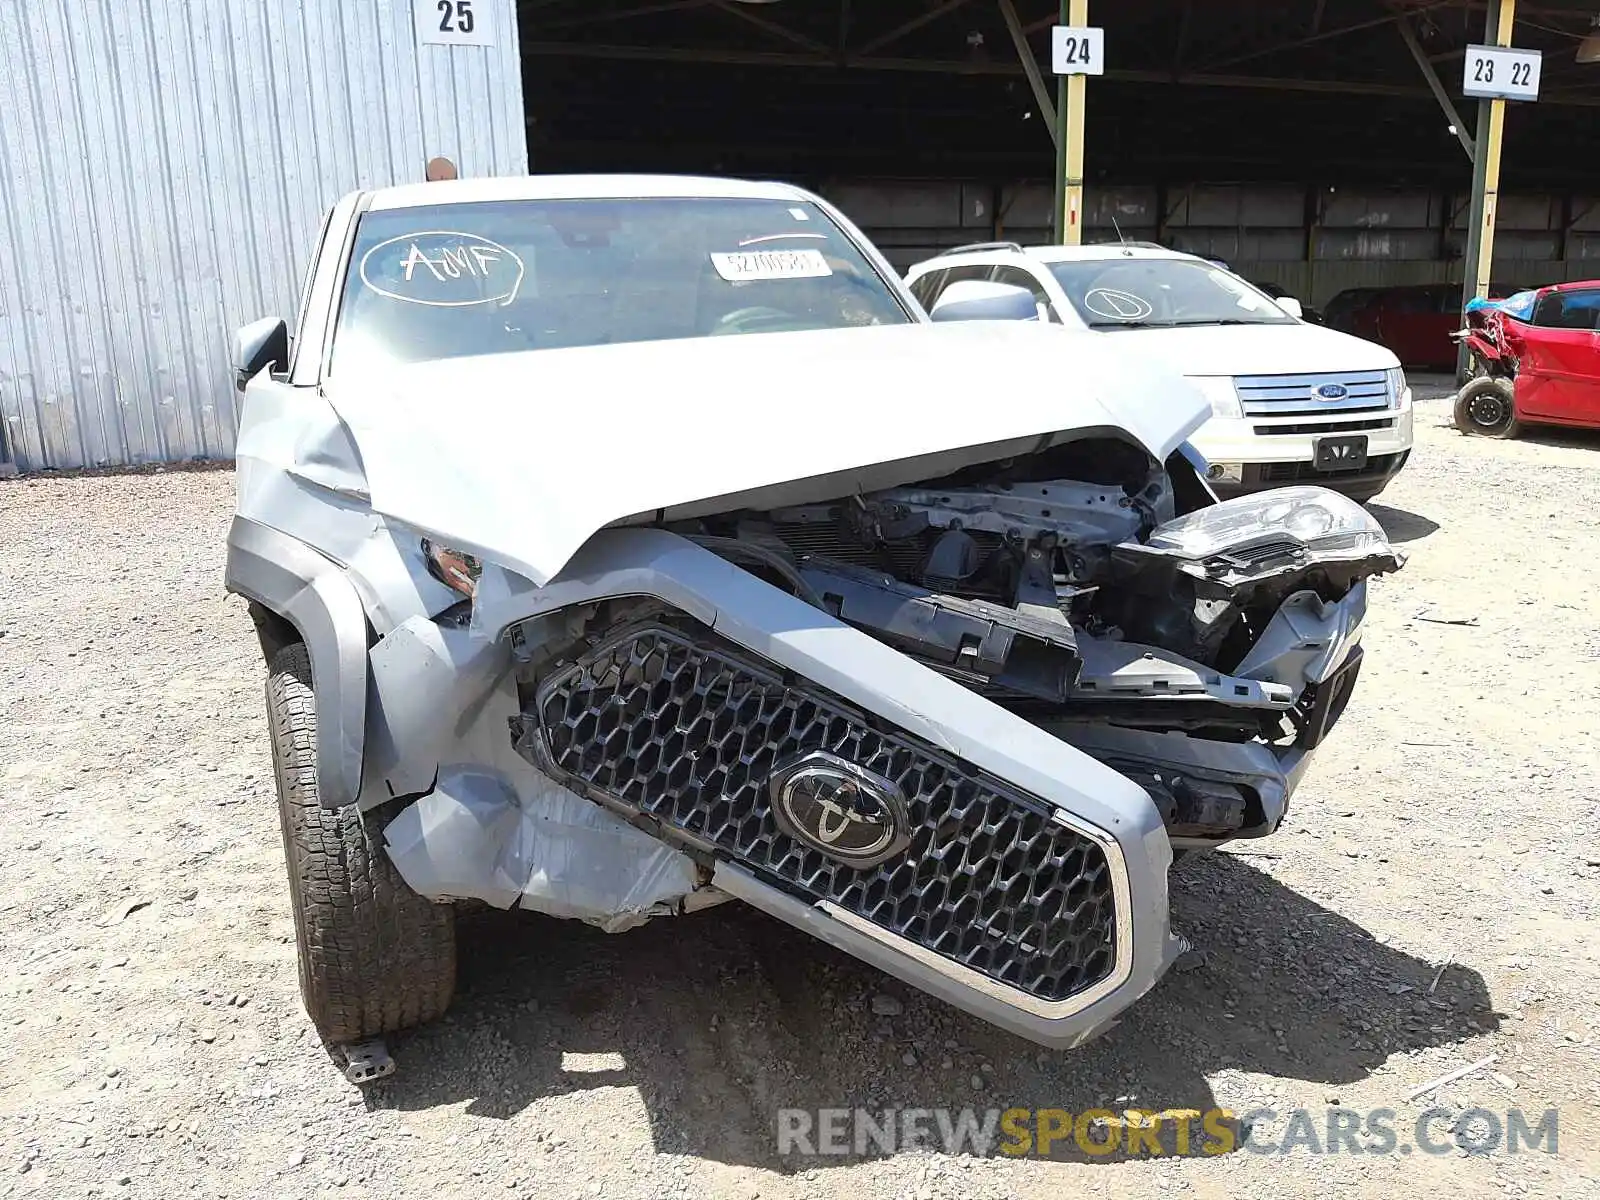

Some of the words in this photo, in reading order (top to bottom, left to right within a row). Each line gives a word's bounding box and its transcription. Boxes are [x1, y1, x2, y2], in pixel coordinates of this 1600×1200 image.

[437, 0, 474, 33] 25
[1066, 37, 1090, 64] 24
[1474, 58, 1494, 83] 23
[1511, 62, 1531, 86] 22
